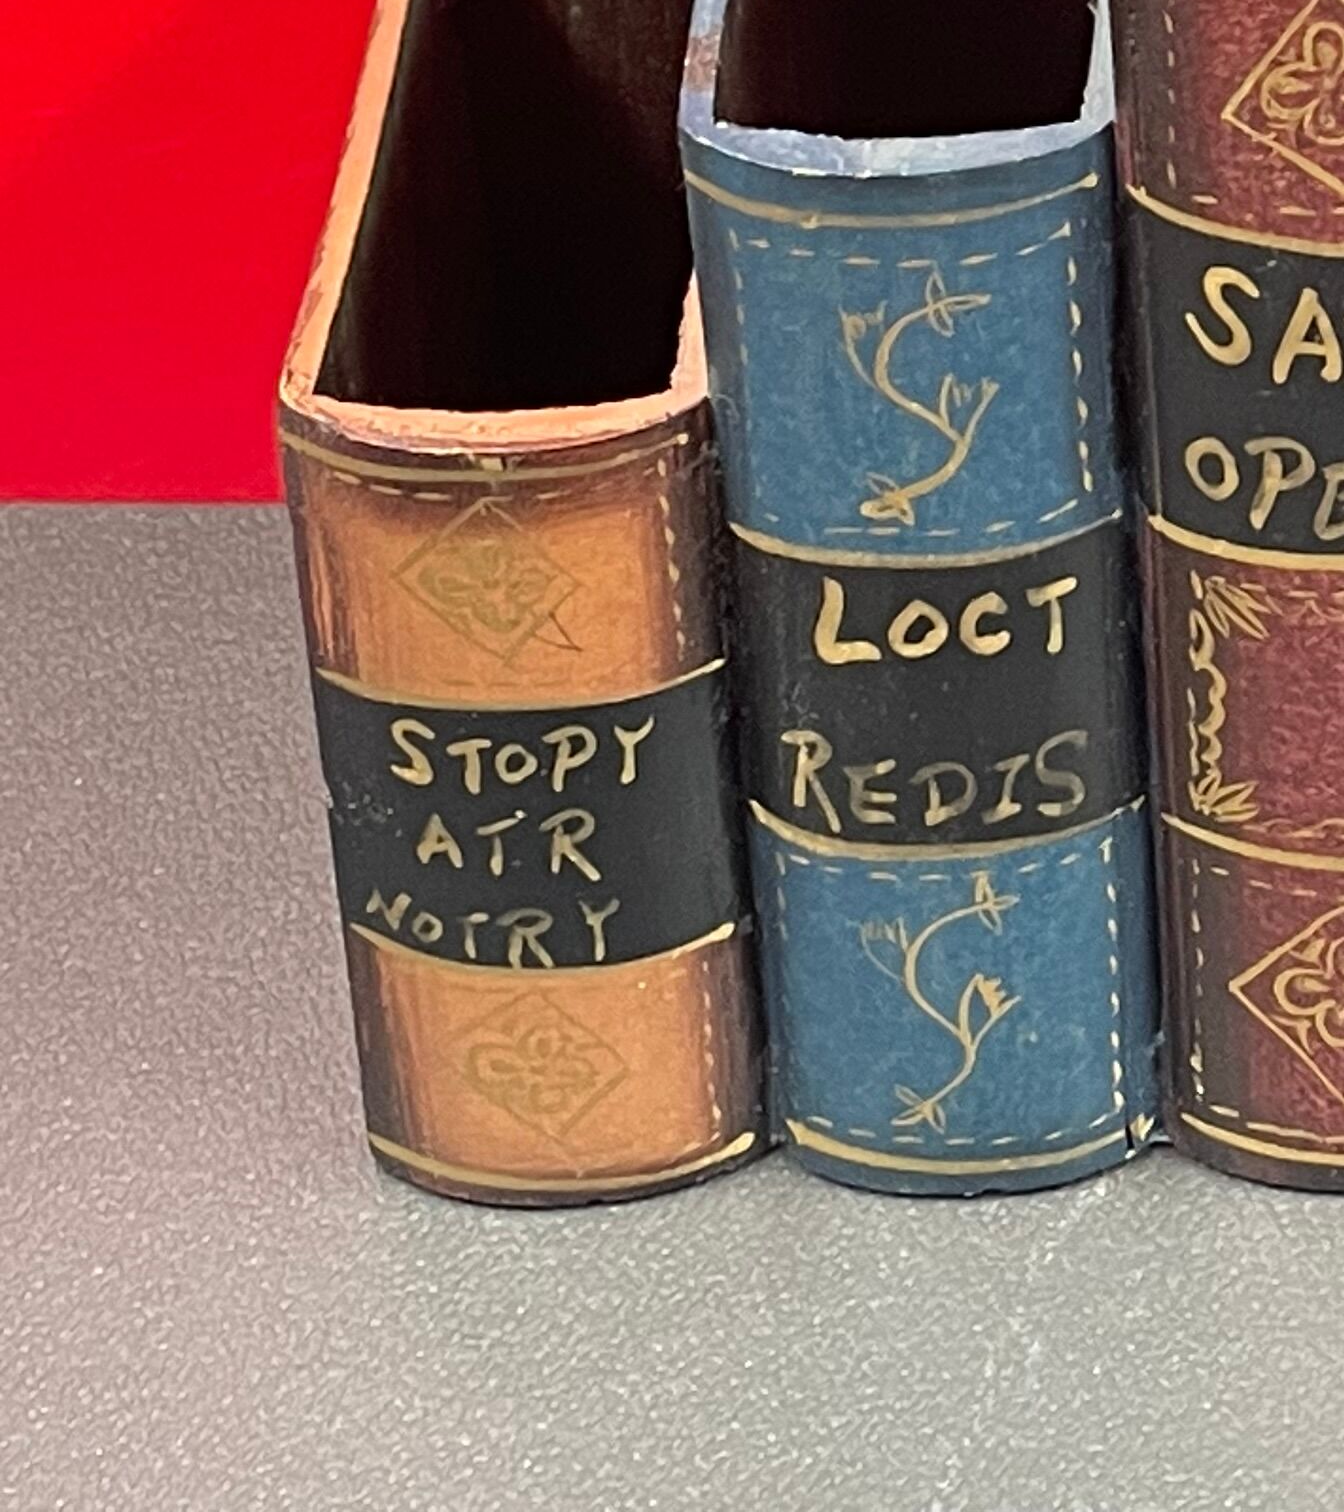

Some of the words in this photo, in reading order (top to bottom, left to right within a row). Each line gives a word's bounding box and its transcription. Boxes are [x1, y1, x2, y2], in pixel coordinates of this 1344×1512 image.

[812, 575, 1080, 666] LOCT
[389, 714, 658, 795] STOPY
[780, 728, 1091, 834] REDIS
[416, 807, 602, 883] ATR
[364, 888, 621, 970] NOTRY
